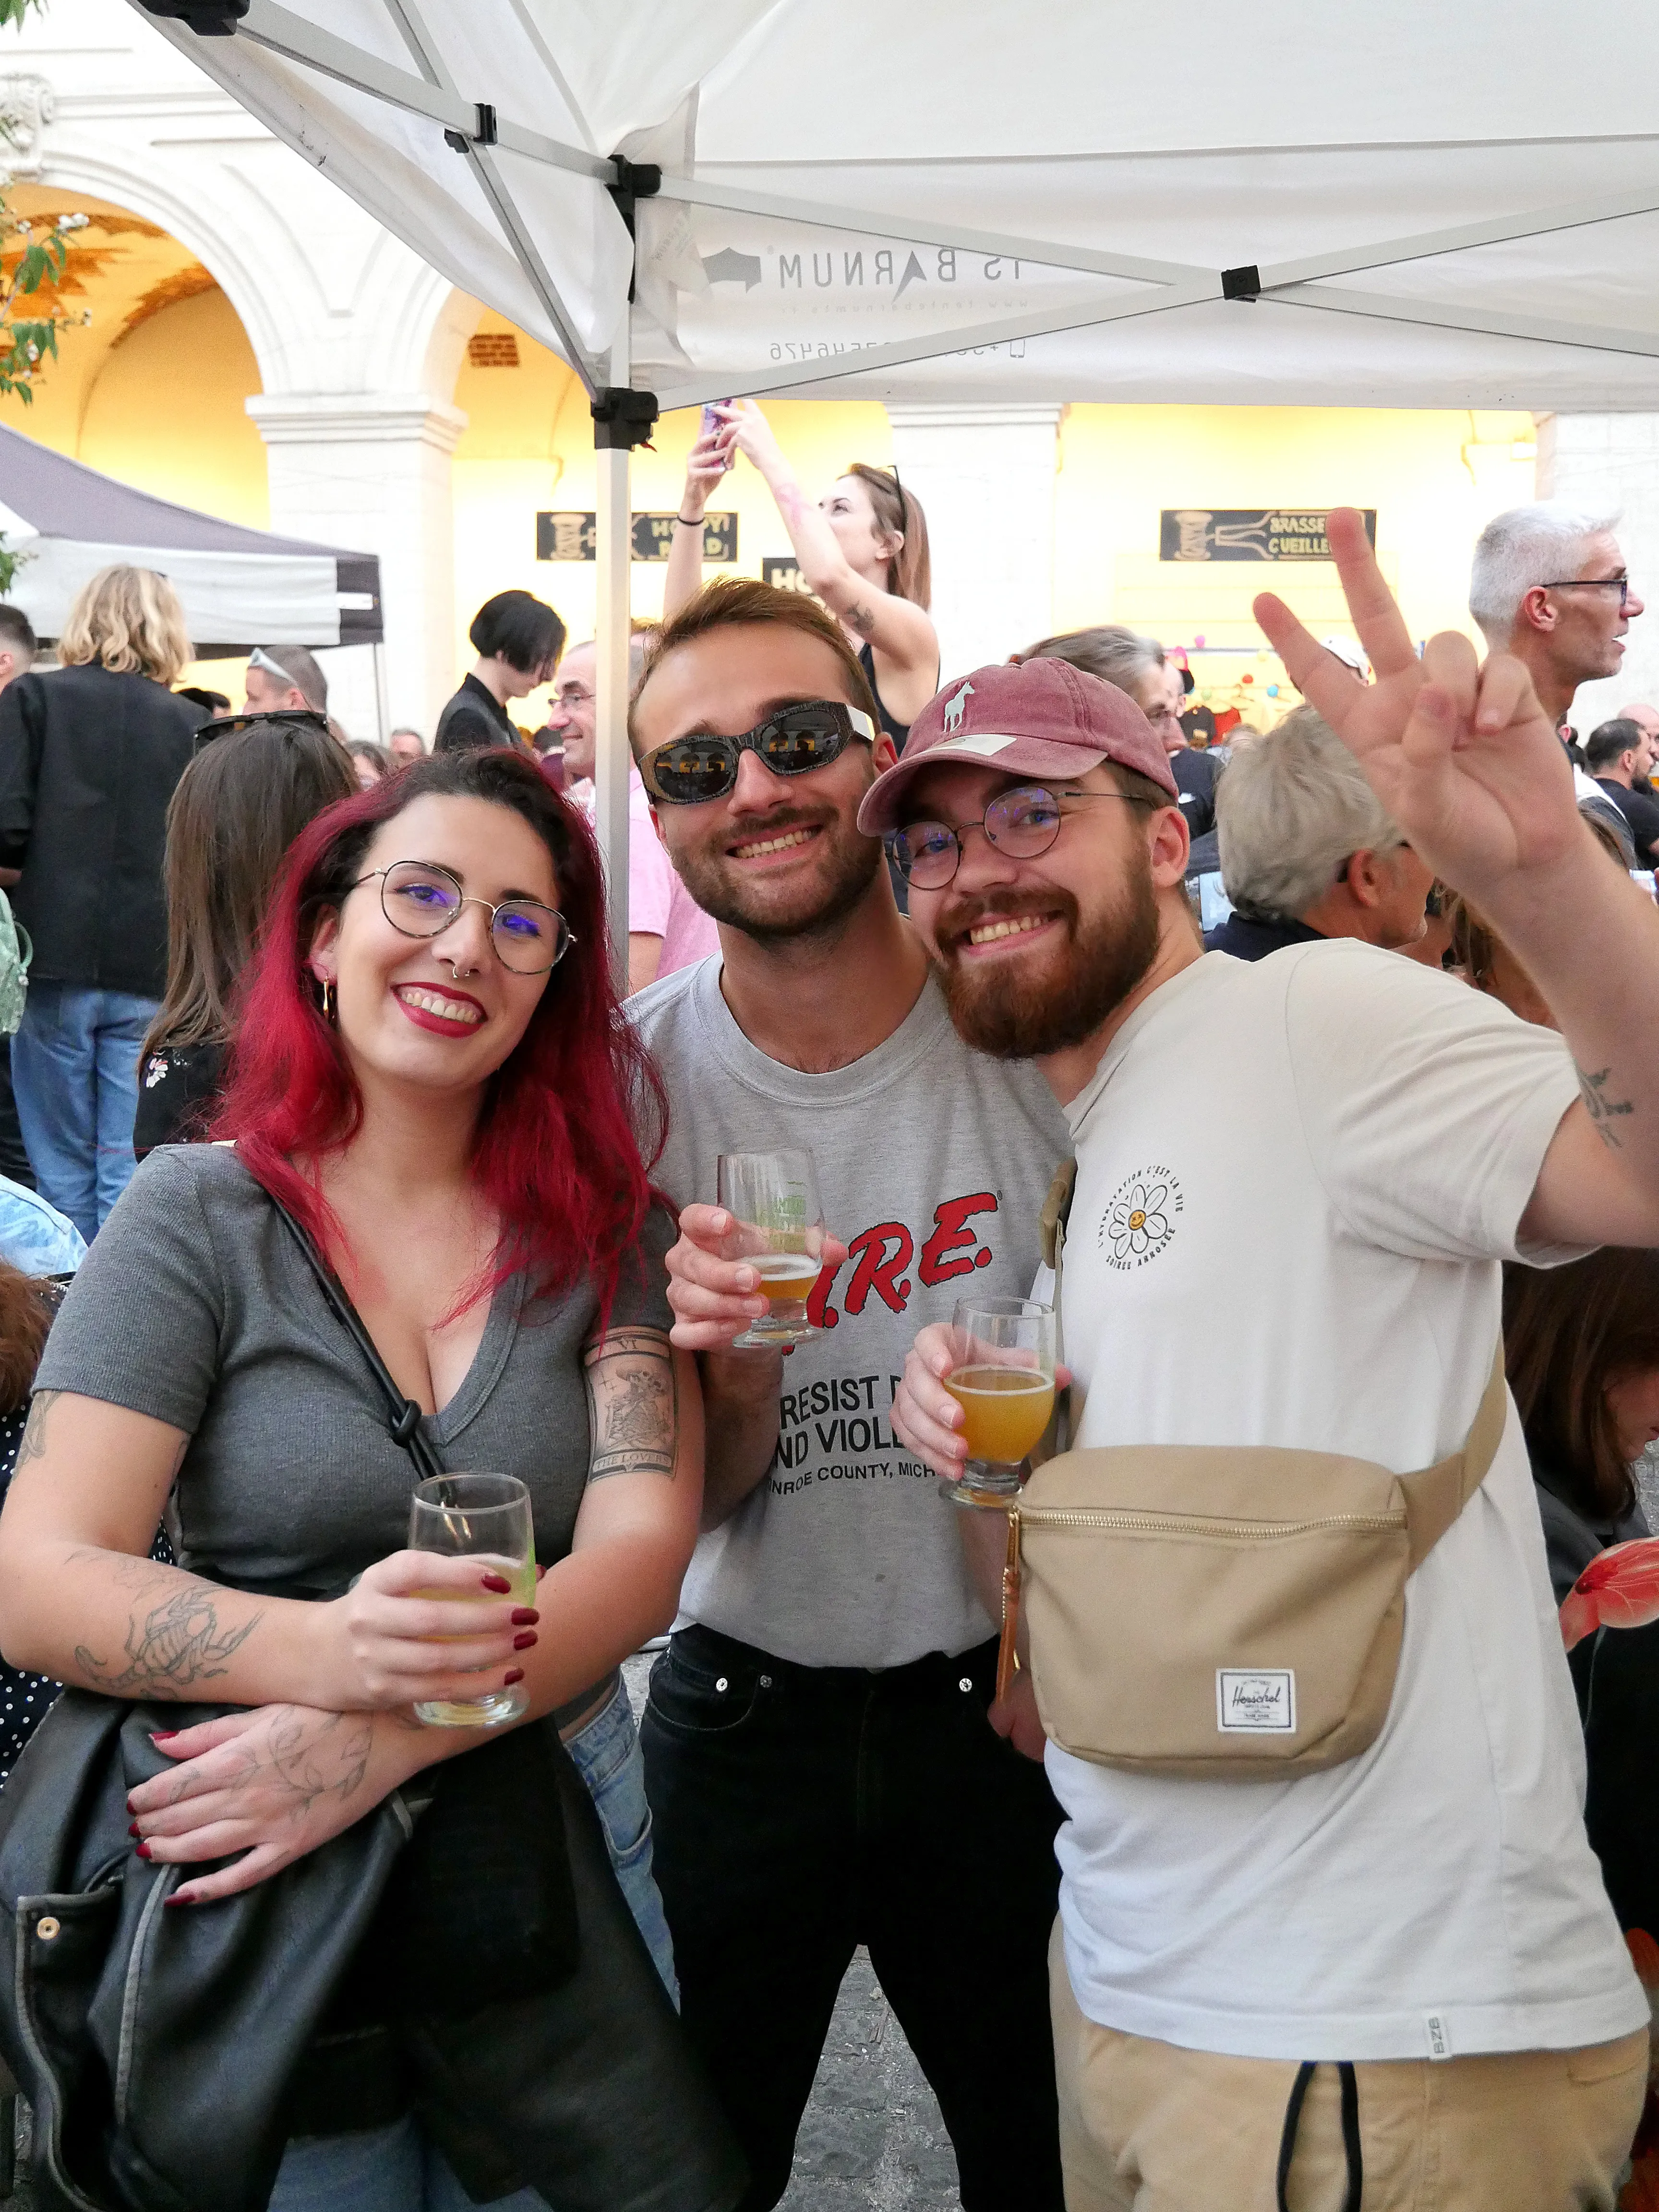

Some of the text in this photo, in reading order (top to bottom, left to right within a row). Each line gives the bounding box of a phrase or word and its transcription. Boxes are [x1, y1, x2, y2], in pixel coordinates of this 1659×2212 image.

[1175, 1193, 1183, 1212] VIE
[780, 1375, 879, 1430] RESIST
[622, 1453, 671, 1464] LOVERS
[775, 1430, 808, 1468] ND
[769, 1462, 936, 1495] NROE COUNTY, MICH
